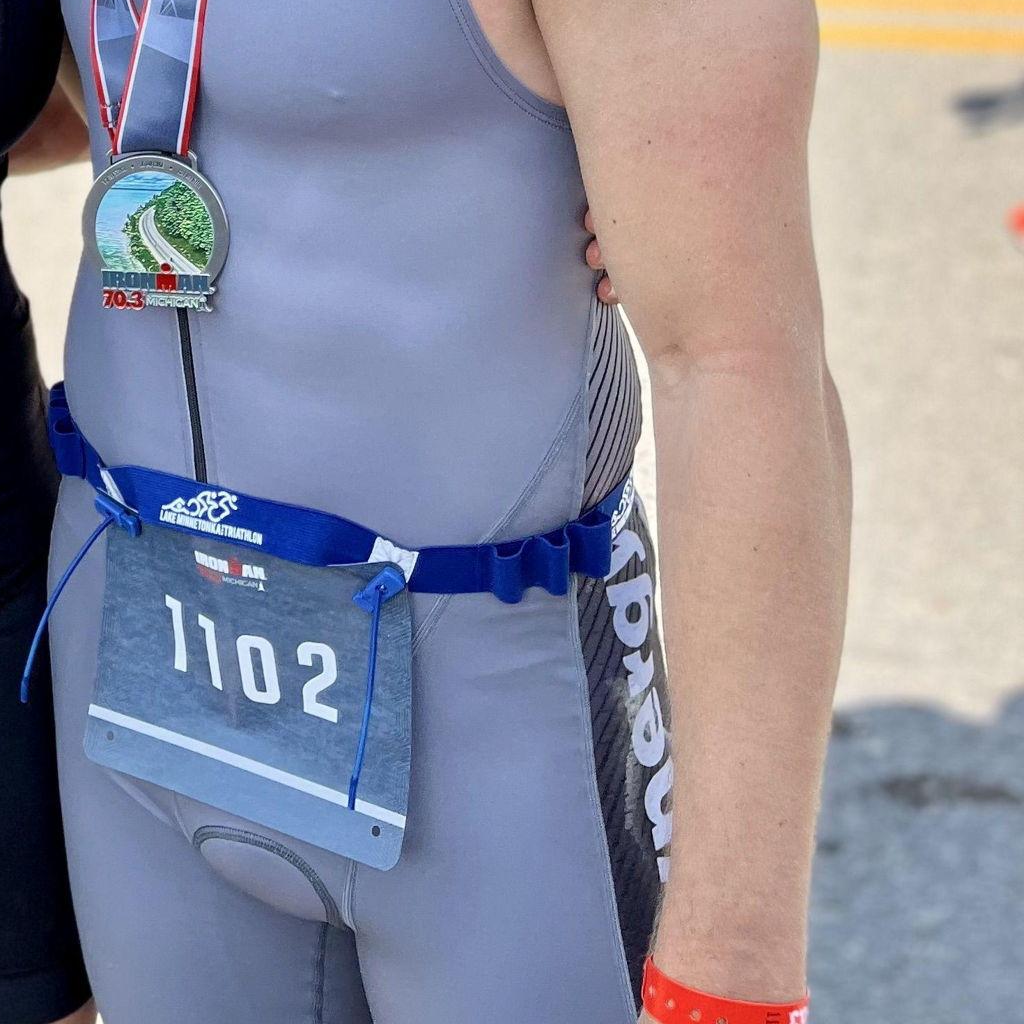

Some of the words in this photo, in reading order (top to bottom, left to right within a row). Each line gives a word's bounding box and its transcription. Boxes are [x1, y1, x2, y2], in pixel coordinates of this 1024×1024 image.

[103, 290, 145, 310] 70.3
[146, 297, 199, 308] MICHIGAN
[159, 509, 176, 524] LAKE
[194, 550, 266, 580] IRONMAN
[165, 594, 338, 724] 1102
